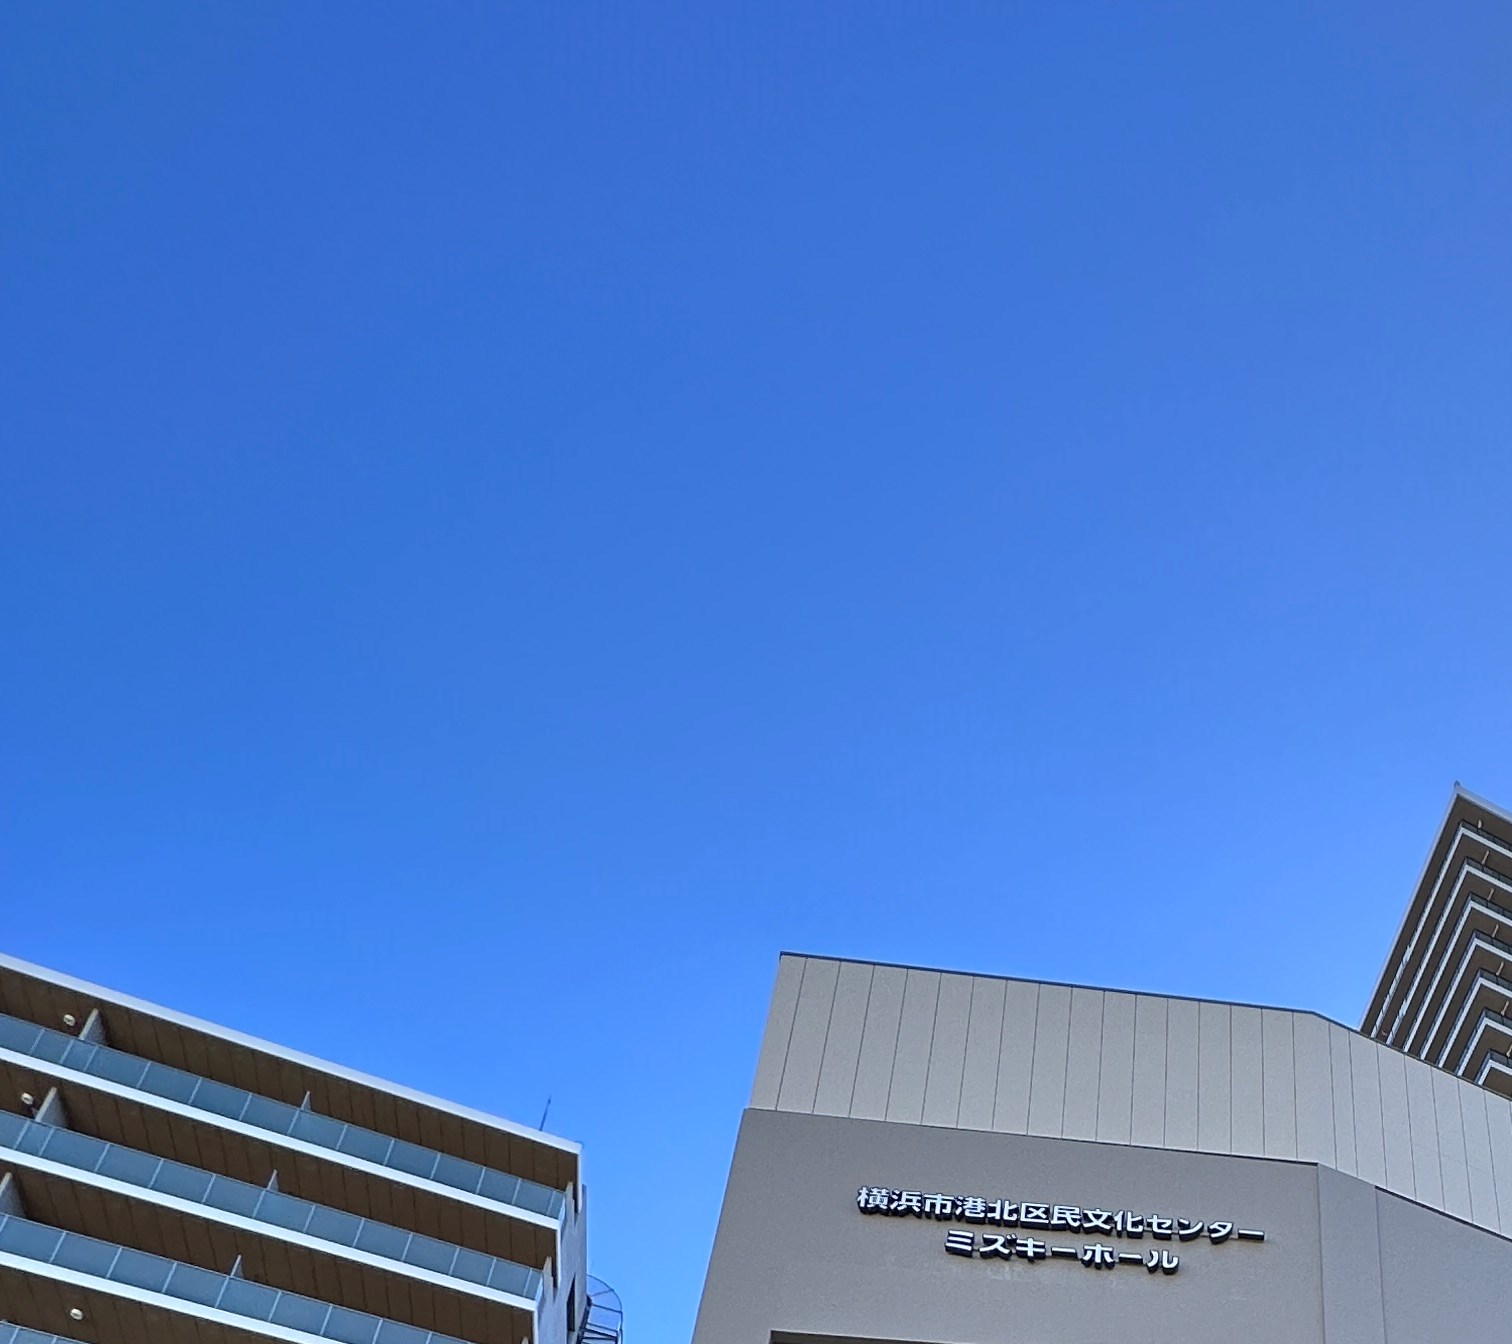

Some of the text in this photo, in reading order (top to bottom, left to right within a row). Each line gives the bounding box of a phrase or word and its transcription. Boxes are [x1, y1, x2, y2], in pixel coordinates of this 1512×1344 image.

[857, 1187, 1265, 1243] 横浜市港北区民文化センター
[945, 1230, 1179, 1273] ミズキーホール
